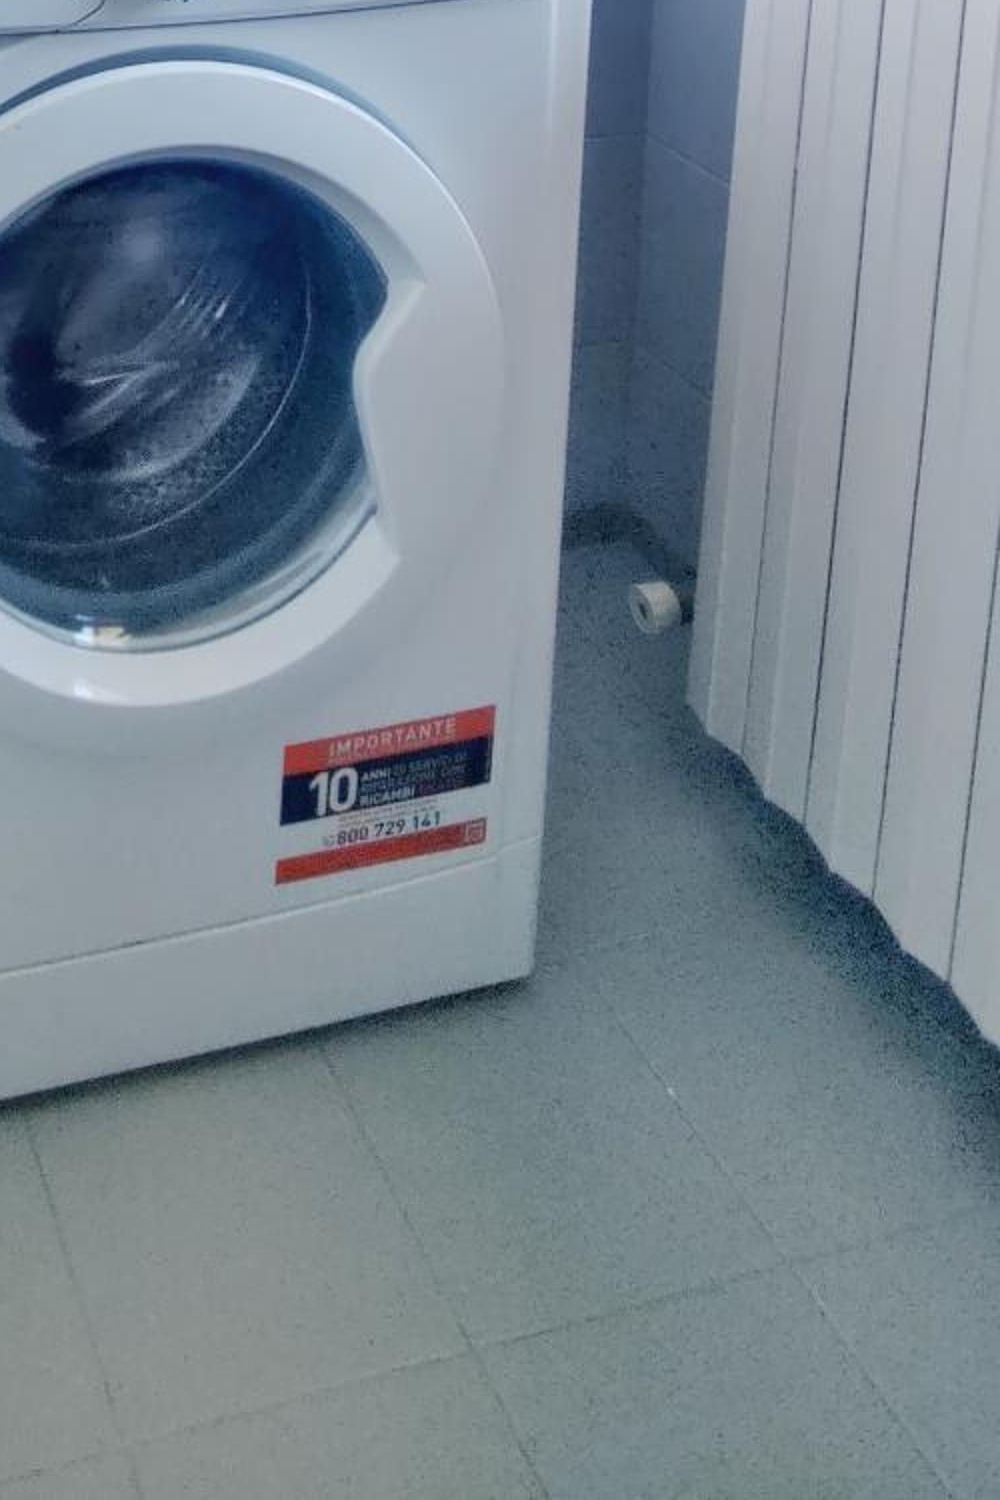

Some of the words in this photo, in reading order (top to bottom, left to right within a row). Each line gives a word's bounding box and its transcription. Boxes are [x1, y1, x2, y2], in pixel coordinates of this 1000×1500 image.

[329, 718, 457, 757] IMPORTANTE
[309, 767, 359, 817] 10
[337, 825, 370, 845] 800
[374, 820, 406, 837] 729
